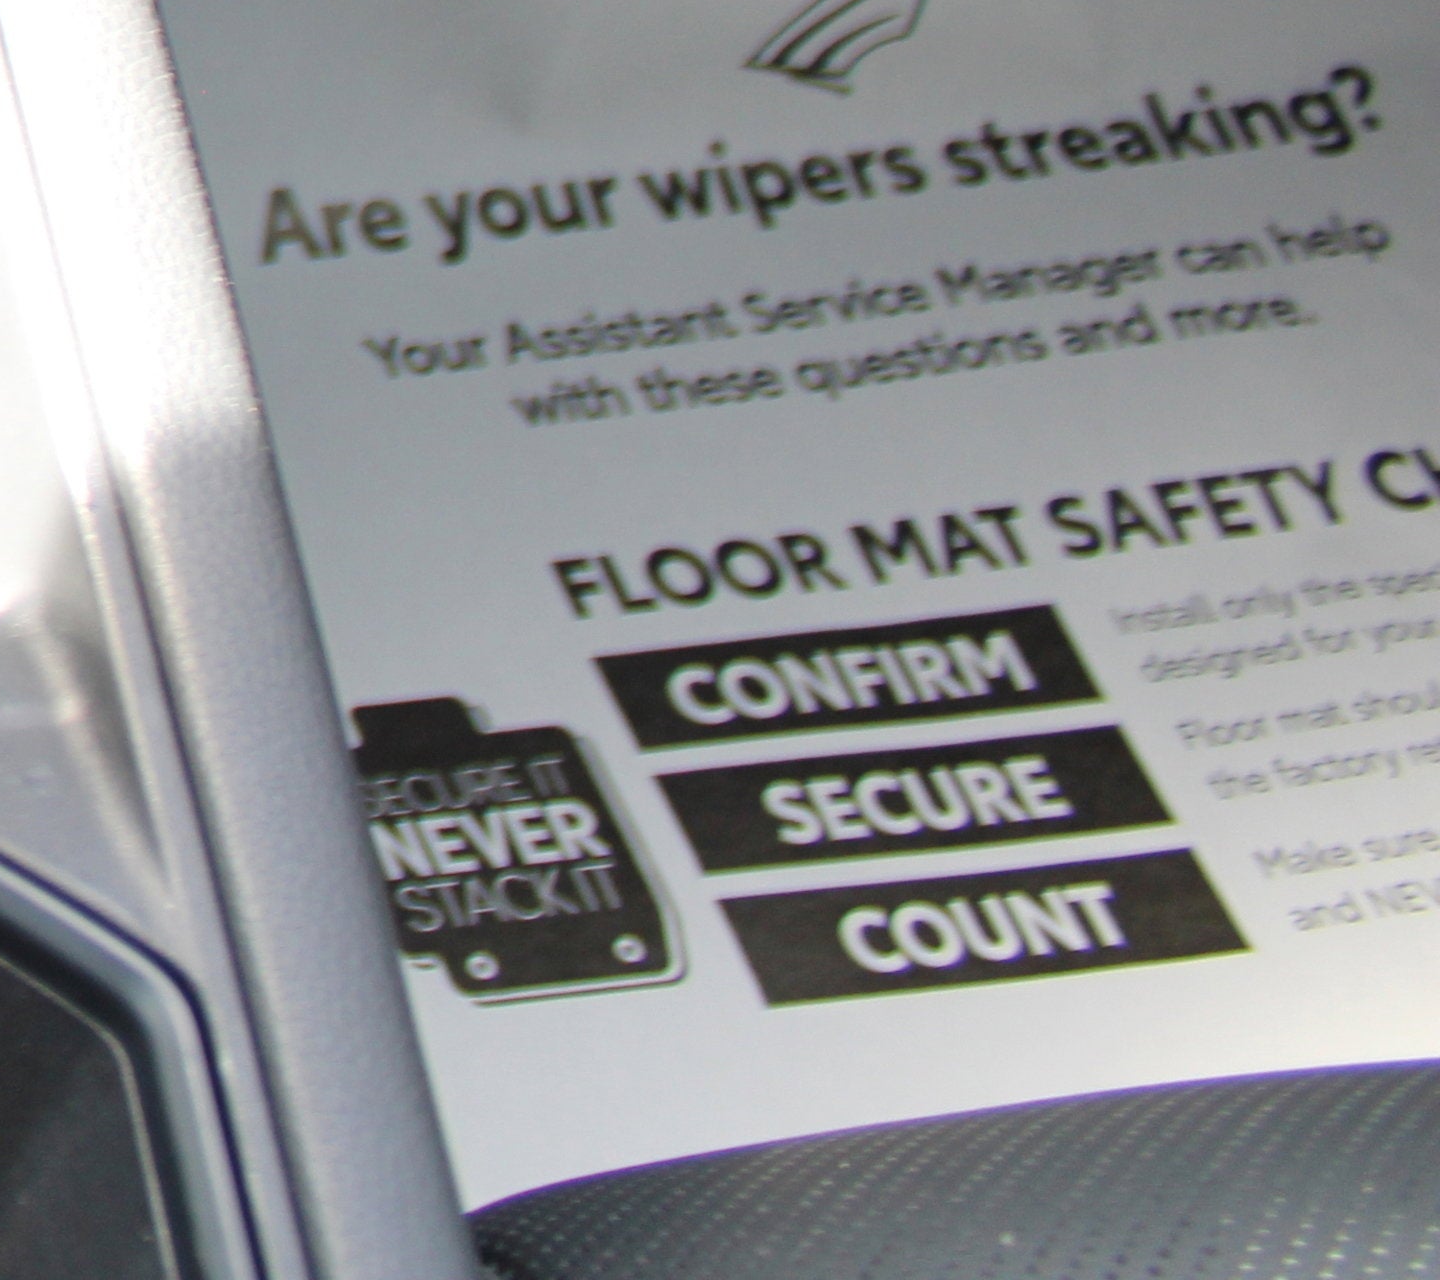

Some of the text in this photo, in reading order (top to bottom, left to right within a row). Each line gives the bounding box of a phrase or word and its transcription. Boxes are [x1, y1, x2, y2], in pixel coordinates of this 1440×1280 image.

[258, 65, 1384, 264] Are your wipers streaking?
[363, 212, 1392, 380] Your Assistant Service Manager can help
[510, 288, 1319, 429] with these questions and more.
[551, 457, 1342, 620] FLOOR MAT SAFETY
[666, 631, 1037, 726] CONFIRM
[1141, 629, 1304, 684] designed
[357, 755, 570, 819] SECURE IT
[763, 755, 1073, 848] SECURE
[369, 800, 614, 882] NEVER
[393, 861, 624, 933] STACK IT
[838, 882, 1126, 976] COUNT
